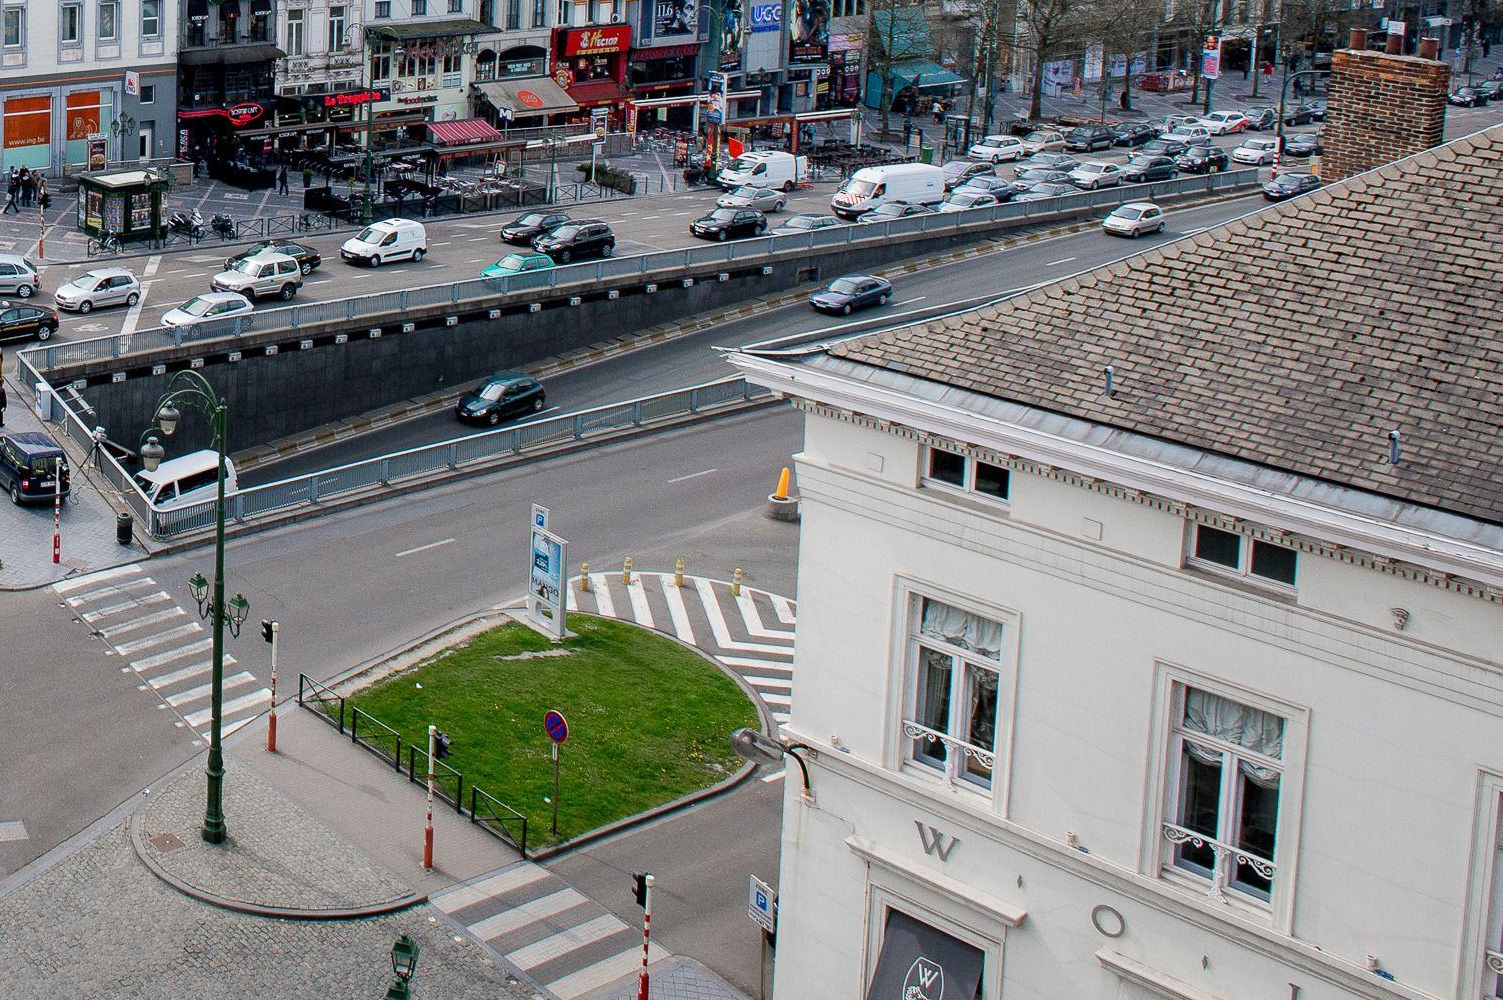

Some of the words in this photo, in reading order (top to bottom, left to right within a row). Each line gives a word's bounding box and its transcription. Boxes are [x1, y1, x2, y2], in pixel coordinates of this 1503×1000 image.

[657, 4, 674, 18] 11.6
[753, 4, 782, 22] UGC
[8, 136, 47, 147] www.ing.be
[914, 820, 960, 863] W
[918, 962, 940, 989] W
